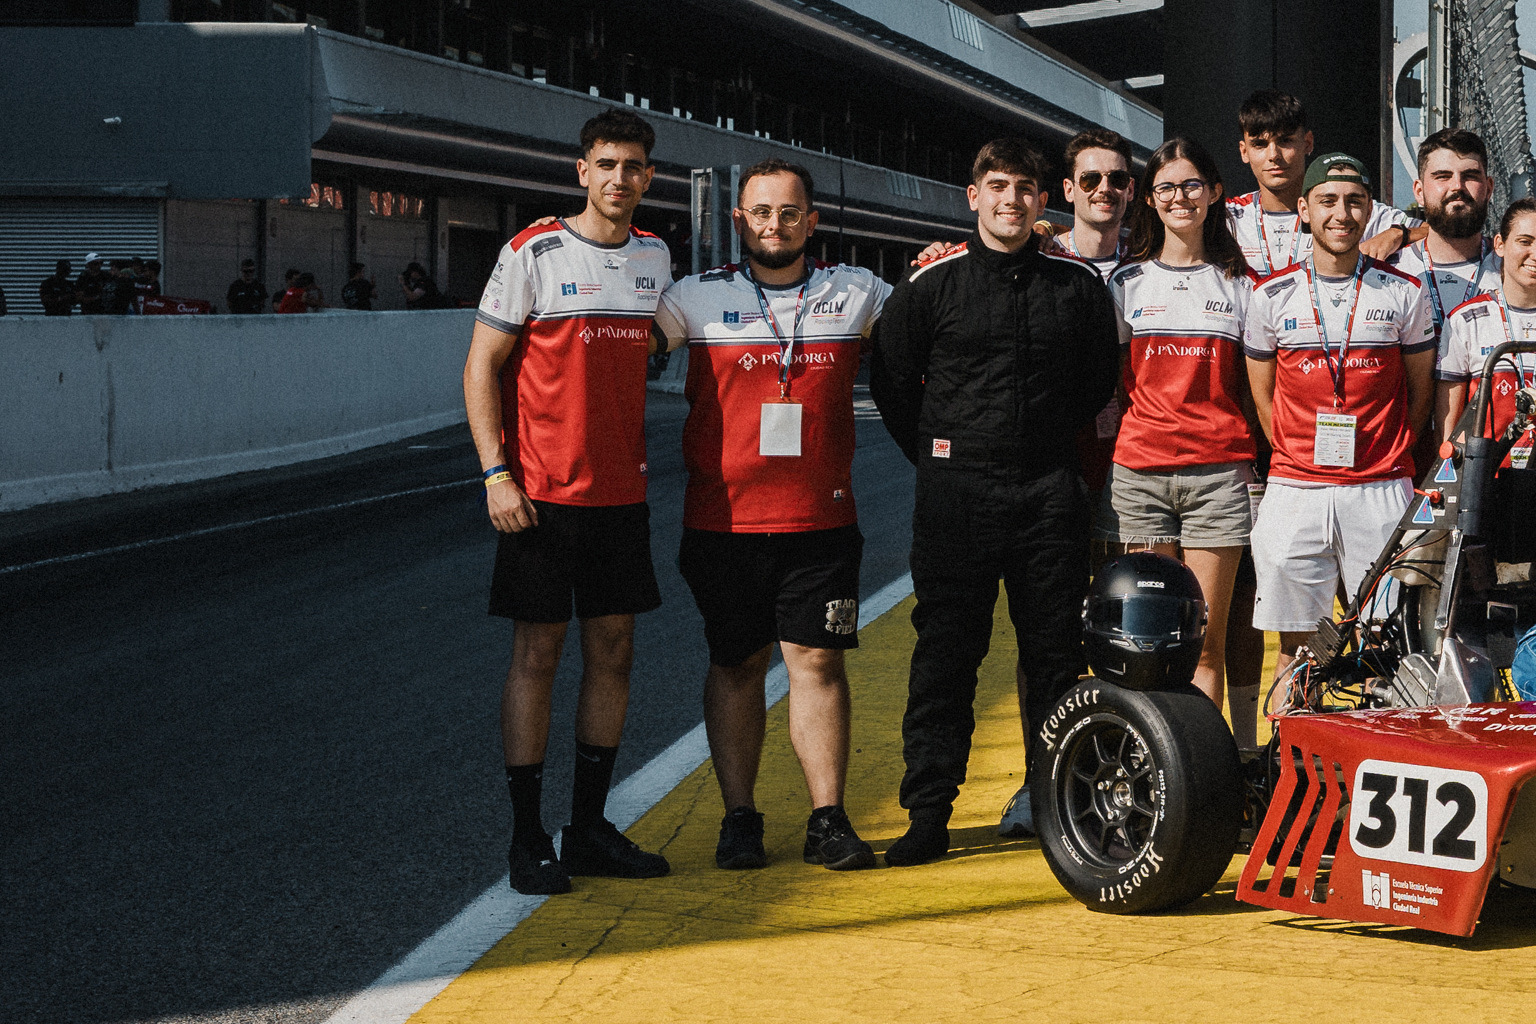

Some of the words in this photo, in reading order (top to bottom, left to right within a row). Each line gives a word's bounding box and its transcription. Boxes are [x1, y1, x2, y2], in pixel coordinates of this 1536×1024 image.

[635, 276, 656, 290] UCLM
[813, 300, 845, 315] UCLM
[1205, 299, 1234, 315] UCLM
[1365, 308, 1396, 323] UCLM
[597, 326, 649, 340] PANDORGA
[1157, 343, 1217, 358] PANDORGA
[934, 442, 949, 451] OMP
[825, 598, 857, 612] TRAC
[1039, 688, 1100, 751] Hoosier
[1355, 772, 1477, 861] 312
[1099, 841, 1164, 904] Hoosier
